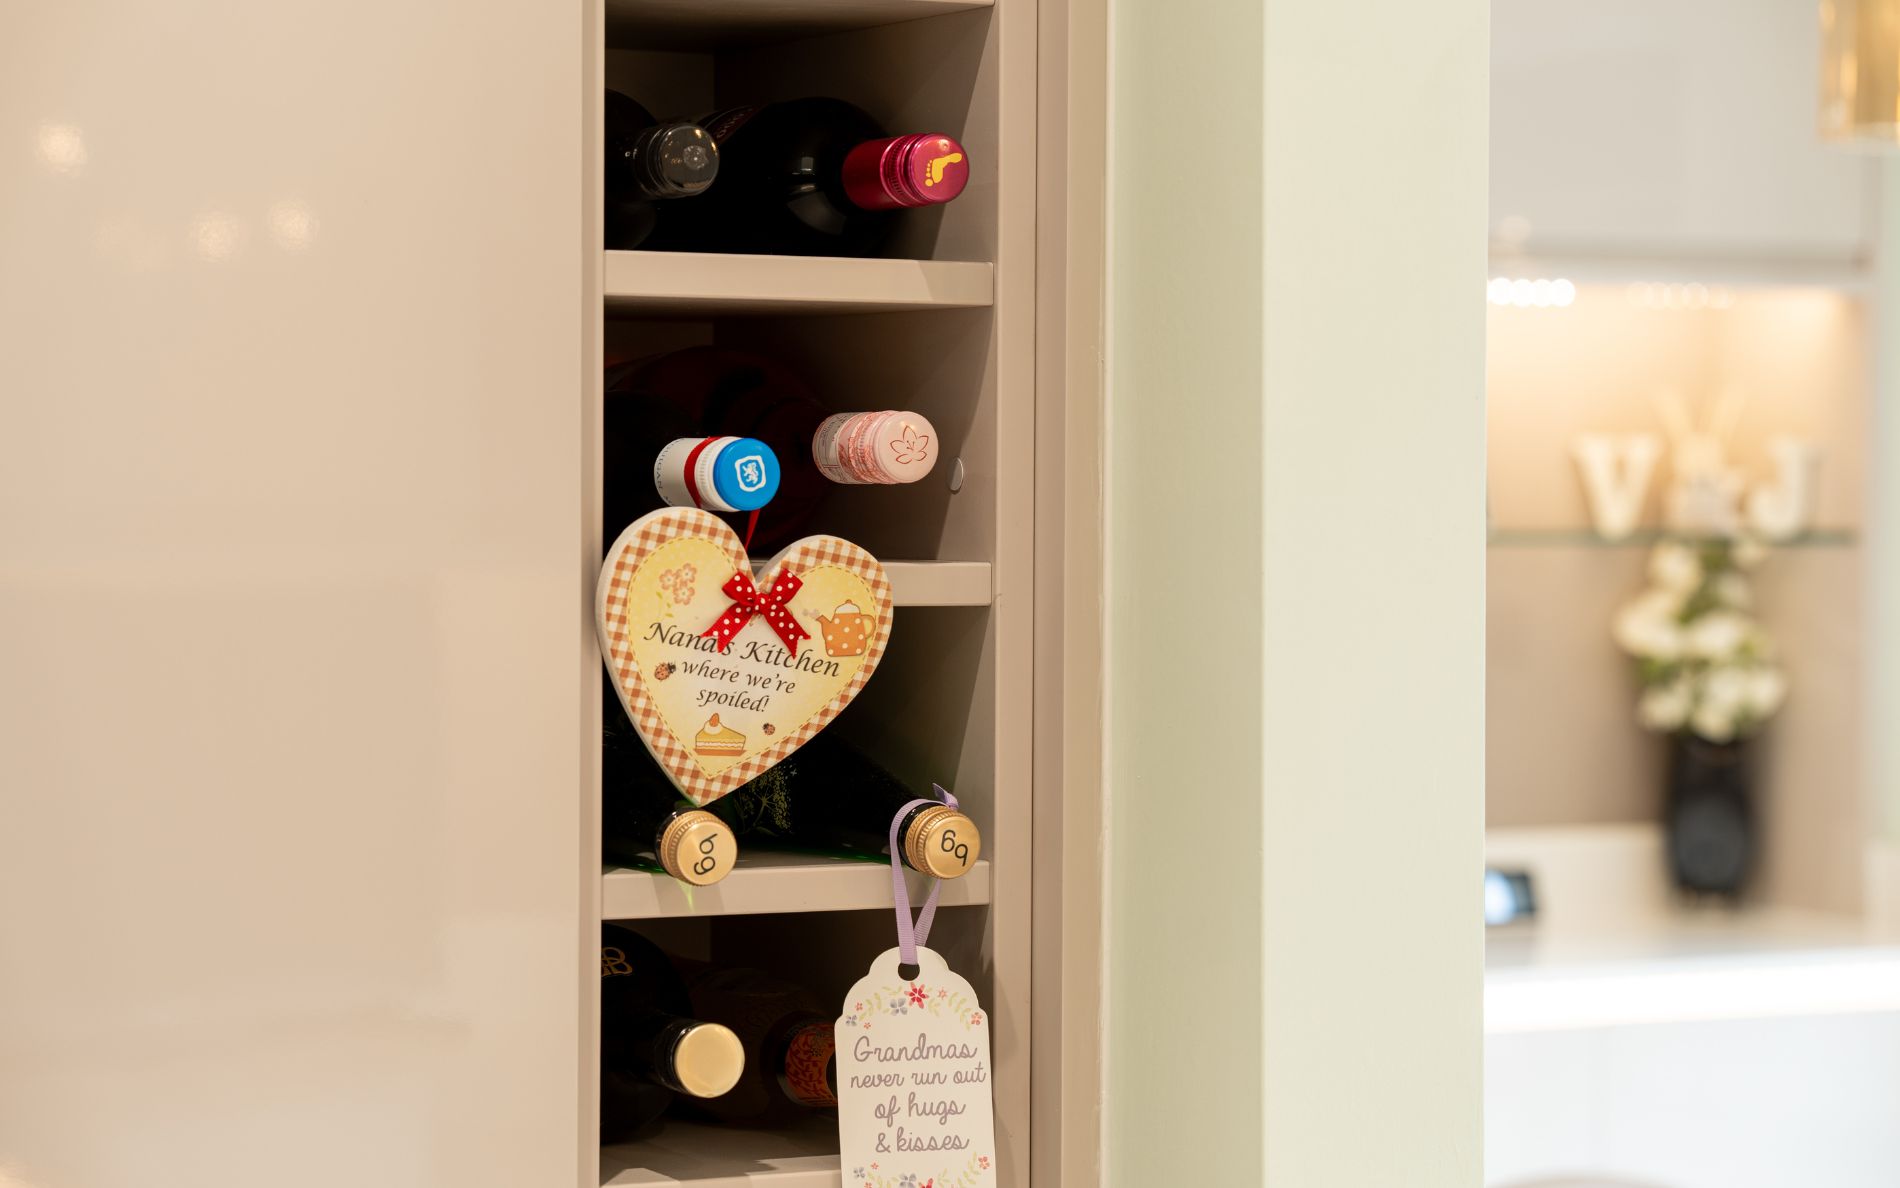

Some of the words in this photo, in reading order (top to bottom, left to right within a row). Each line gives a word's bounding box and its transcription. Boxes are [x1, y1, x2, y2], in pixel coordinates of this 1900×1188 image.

[1571, 432, 1660, 539] V
[643, 622, 735, 656] Nanas
[740, 641, 840, 677] Kitchen
[682, 660, 740, 683] where
[746, 673, 796, 694] we're
[696, 688, 770, 712] spoiled!
[853, 1032, 978, 1063] Grandmas
[850, 1072, 905, 1089] never
[911, 1071, 948, 1086] run
[953, 1061, 987, 1084] out
[874, 1095, 901, 1128] of
[908, 1091, 967, 1126] hugs
[875, 1132, 891, 1154] &
[896, 1126, 970, 1152] kisses
